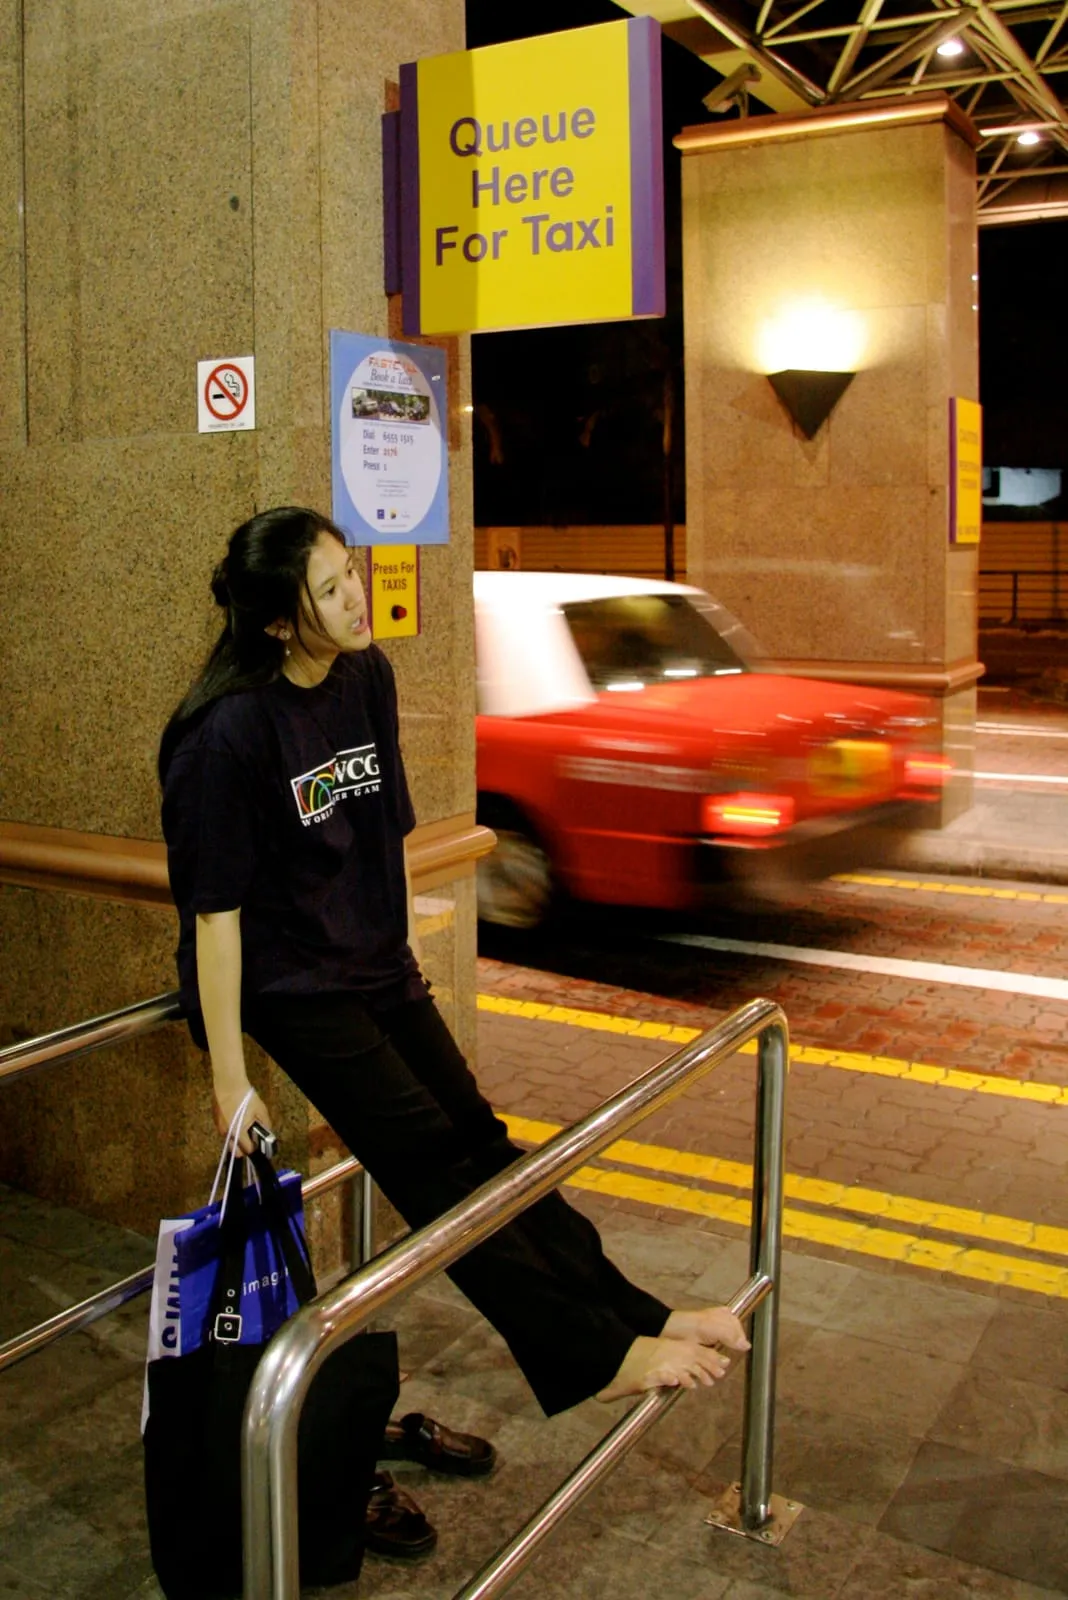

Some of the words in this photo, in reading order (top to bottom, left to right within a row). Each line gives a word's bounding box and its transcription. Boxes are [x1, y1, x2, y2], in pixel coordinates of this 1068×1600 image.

[449, 106, 596, 158] Queue
[471, 164, 575, 209] Here
[435, 226, 508, 267] For
[521, 205, 615, 255] Taxi
[370, 368, 389, 382] Book
[362, 429, 375, 440] Dial
[362, 444, 380, 456] Enter
[362, 459, 380, 471] Press
[373, 562, 398, 575] Press
[400, 561, 415, 574] For
[382, 578, 407, 592] TAXIS
